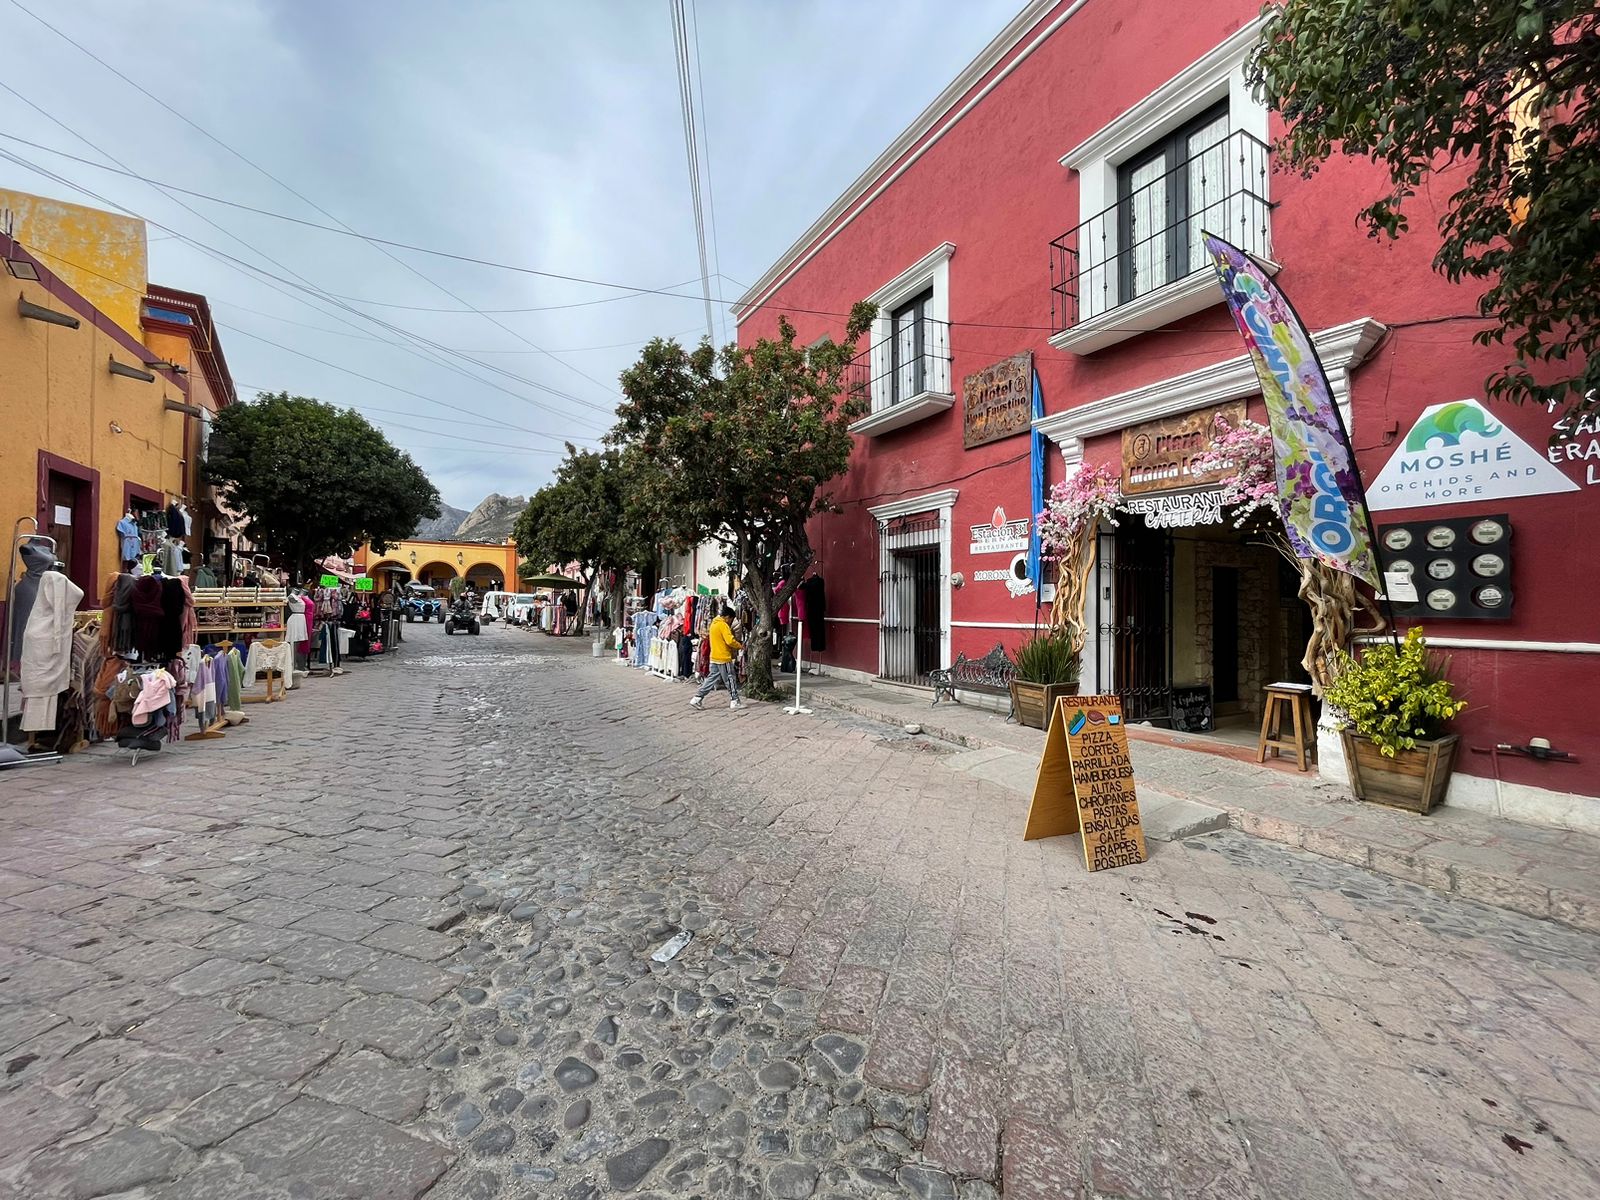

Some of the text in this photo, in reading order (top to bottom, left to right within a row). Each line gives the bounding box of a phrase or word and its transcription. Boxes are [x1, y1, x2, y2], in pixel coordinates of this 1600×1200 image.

[980, 380, 1012, 403] Hotel
[987, 396, 1026, 417] Faustino
[1156, 431, 1202, 454] Plaza
[1400, 442, 1512, 474] MOSHÉ
[1381, 467, 1537, 493] ORCHIDS AND
[1424, 486, 1483, 499] MORE
[1062, 696, 1121, 708] RESTAURANTE
[1082, 731, 1113, 745] PIZZA
[1081, 743, 1119, 758] CORTES
[1072, 754, 1130, 773] PARRILLADA
[1091, 780, 1122, 795] ALITAS
[1093, 803, 1128, 820] PASTAS
[1084, 814, 1140, 834] ENSALADAS
[1094, 839, 1138, 859] FRAPPES
[1094, 851, 1142, 871] POSTRES
